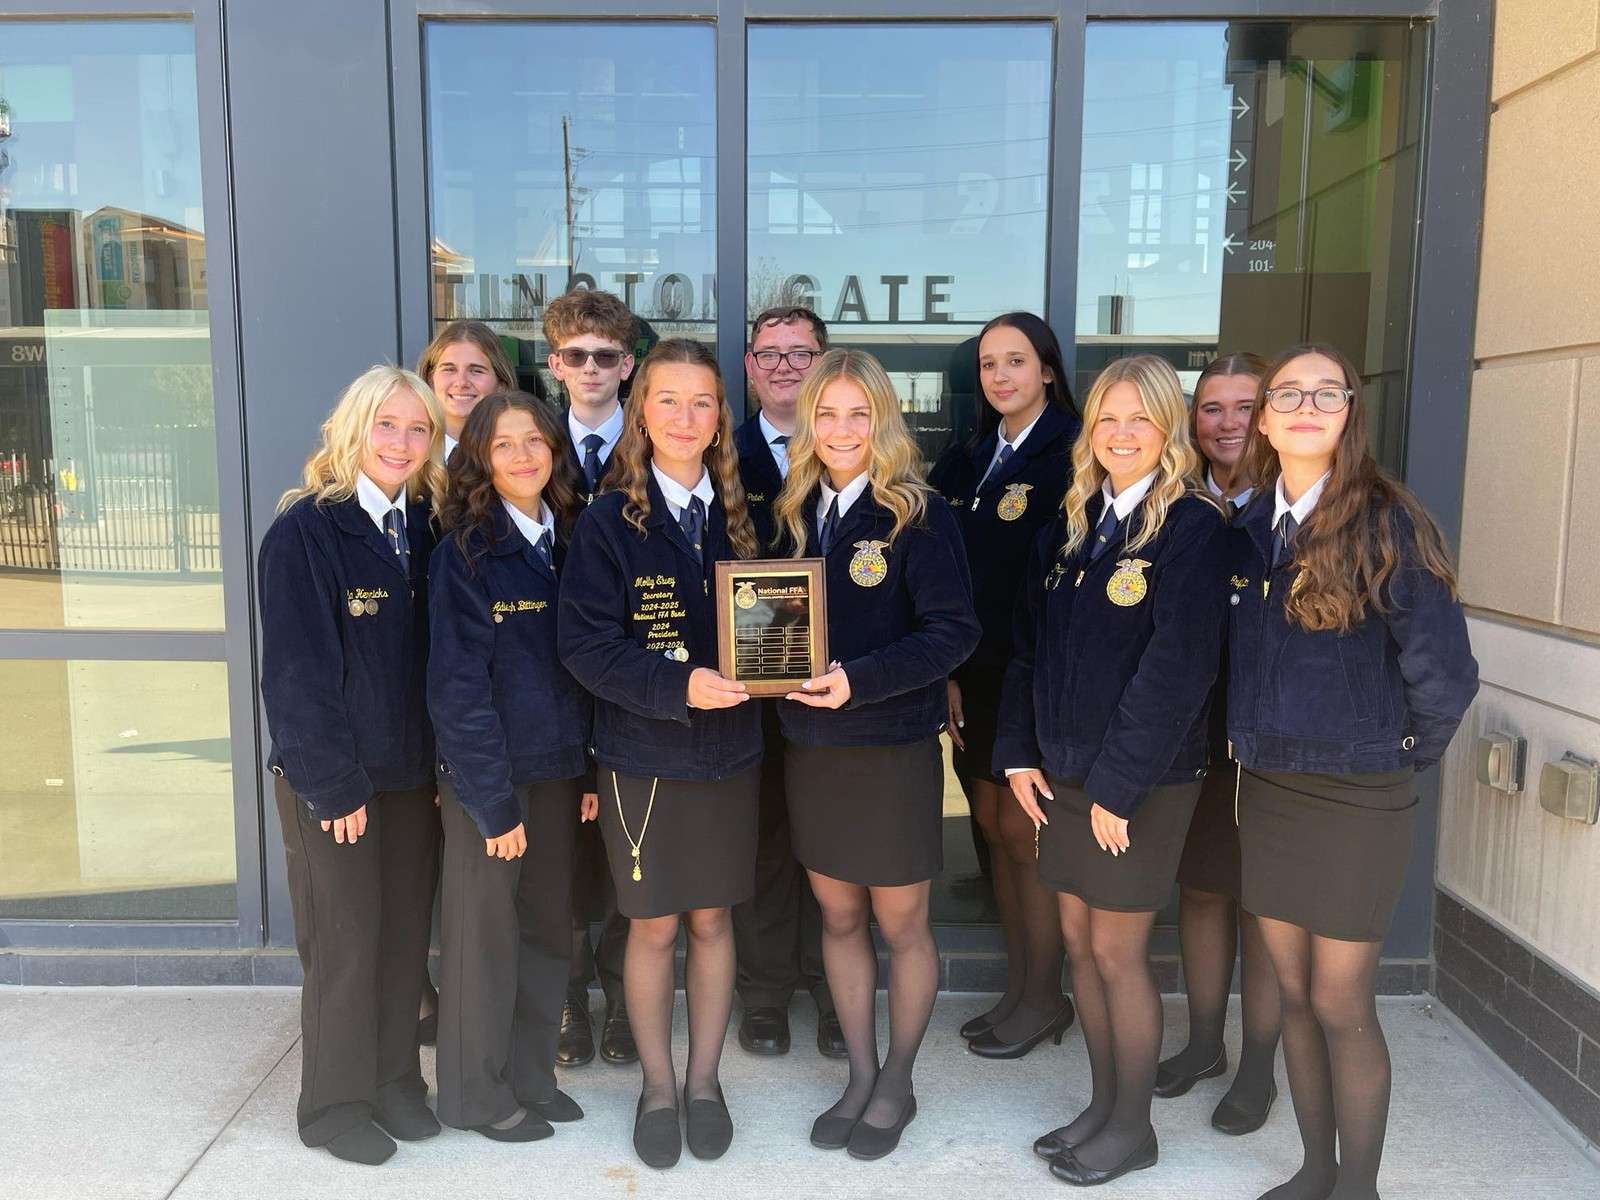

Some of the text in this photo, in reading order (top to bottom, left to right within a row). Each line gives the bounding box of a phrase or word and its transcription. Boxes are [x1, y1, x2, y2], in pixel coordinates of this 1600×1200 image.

[757, 586, 804, 595] National FFA
[641, 591, 674, 600] Secretary
[640, 601, 680, 611] 2024-2025
[633, 610, 686, 621] National FFA Band
[651, 622, 670, 631] 2024
[647, 630, 679, 639] President
[645, 641, 685, 650] 2025-2026
